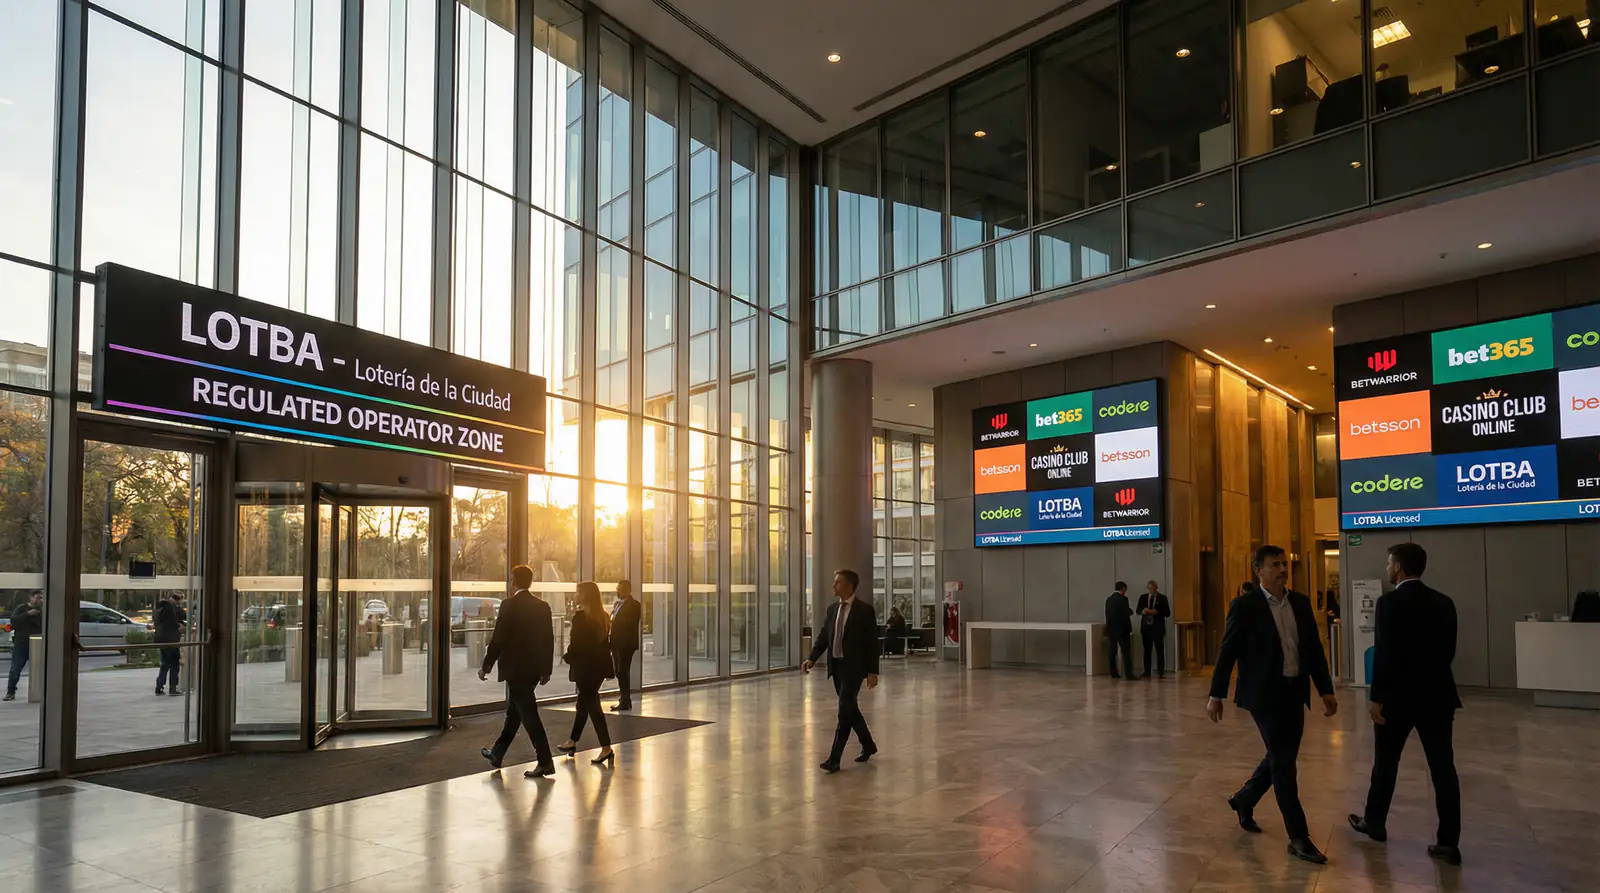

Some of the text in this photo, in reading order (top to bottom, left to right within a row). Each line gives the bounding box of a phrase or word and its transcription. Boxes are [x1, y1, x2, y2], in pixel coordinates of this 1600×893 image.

[181, 302, 324, 371] LOTBA
[355, 358, 415, 391] Lotería
[420, 373, 440, 396] de
[444, 377, 457, 400] la
[462, 384, 511, 412] Ciudad
[1448, 336, 1534, 367] bet365
[1351, 371, 1418, 389] BETWARRIOR
[192, 377, 504, 453] REGULATED OPERATOR ZONE
[1035, 408, 1083, 427] bet365
[1099, 399, 1150, 418] codere
[1442, 395, 1546, 424] CASINO CLUB
[1350, 417, 1421, 436] betsson
[1472, 419, 1515, 436] ONLINE
[1031, 451, 1088, 469] CASINO CLUB
[1101, 448, 1151, 463] betsson
[980, 463, 1021, 476] betsson
[1047, 467, 1072, 479] ONLINE
[1456, 460, 1535, 483] LOTBA
[1350, 474, 1424, 494] codere
[1457, 479, 1536, 493] Lotería de la Ciudad
[980, 506, 1022, 520] codere
[1038, 497, 1082, 513] LOTBA
[1103, 508, 1149, 518] BETWARRIOR
[1353, 513, 1421, 525] LOTBA Licensed
[1103, 527, 1150, 538] LOTBA Licensed
